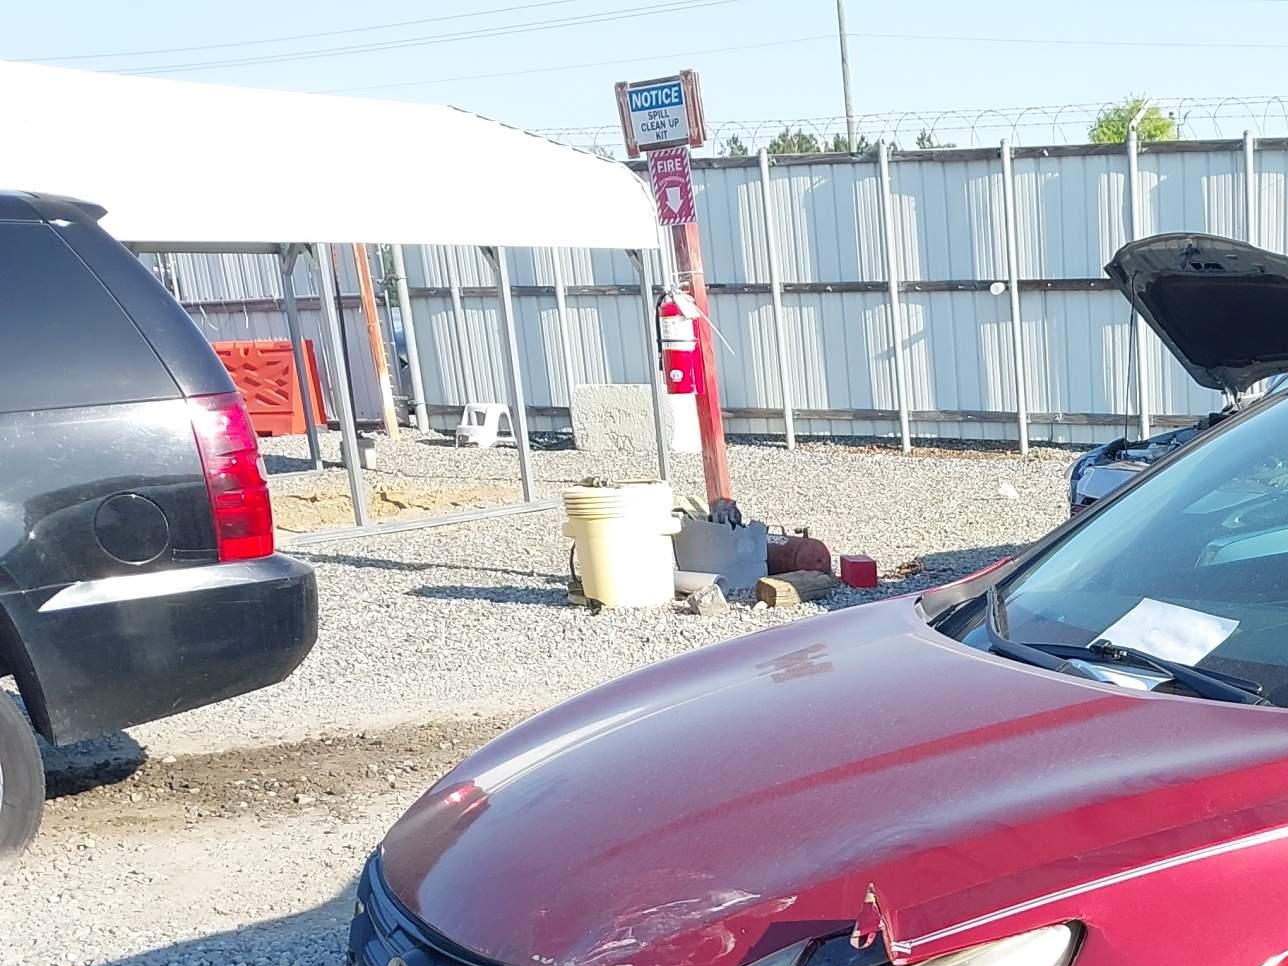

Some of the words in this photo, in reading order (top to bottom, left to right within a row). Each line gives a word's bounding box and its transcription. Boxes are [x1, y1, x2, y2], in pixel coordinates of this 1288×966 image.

[631, 86, 680, 110] NOTICE
[647, 109, 670, 121] SPILL
[640, 119, 666, 132] CLEAN
[668, 117, 680, 128] UP
[655, 130, 668, 140] KIT
[656, 158, 683, 174] FIRE
